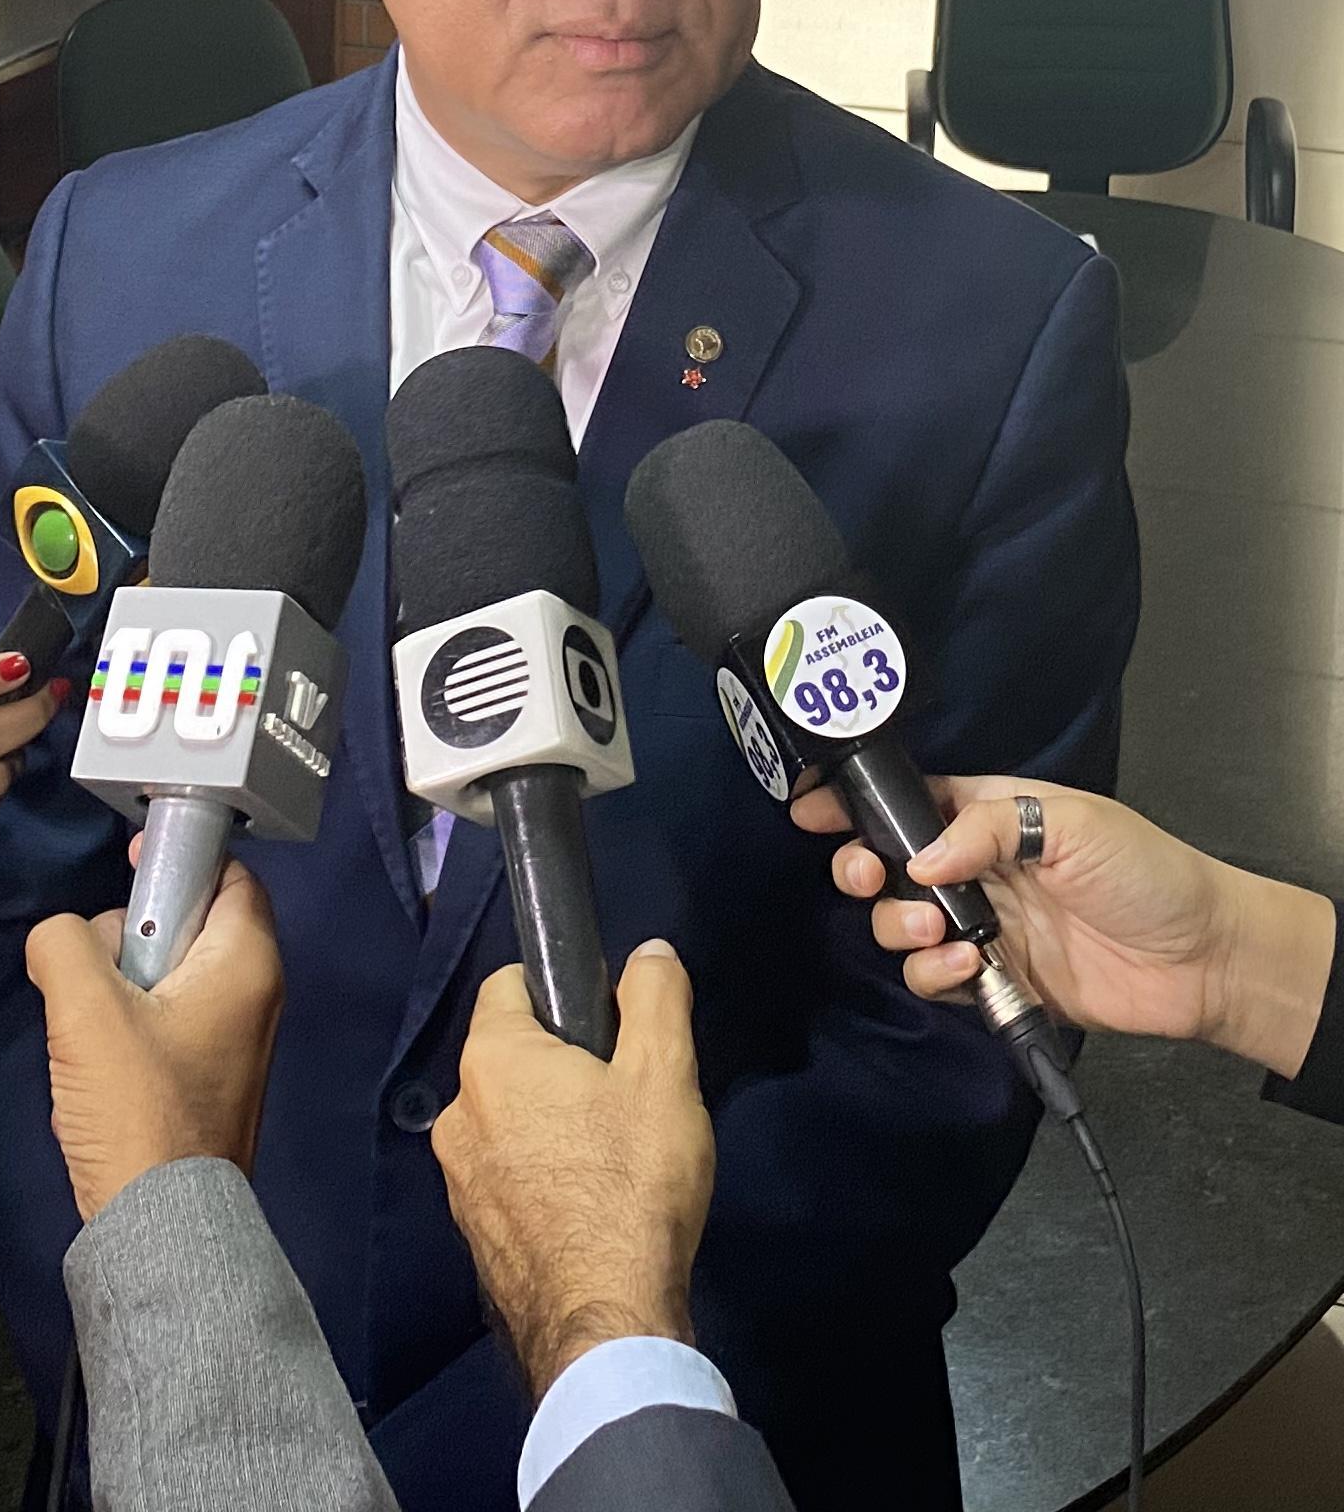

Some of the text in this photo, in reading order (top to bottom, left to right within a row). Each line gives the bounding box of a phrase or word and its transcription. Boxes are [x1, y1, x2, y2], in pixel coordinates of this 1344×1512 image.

[805, 622, 885, 666] ASSEMBLEIA
[815, 624, 840, 644] FM
[793, 648, 900, 727] 98,3
